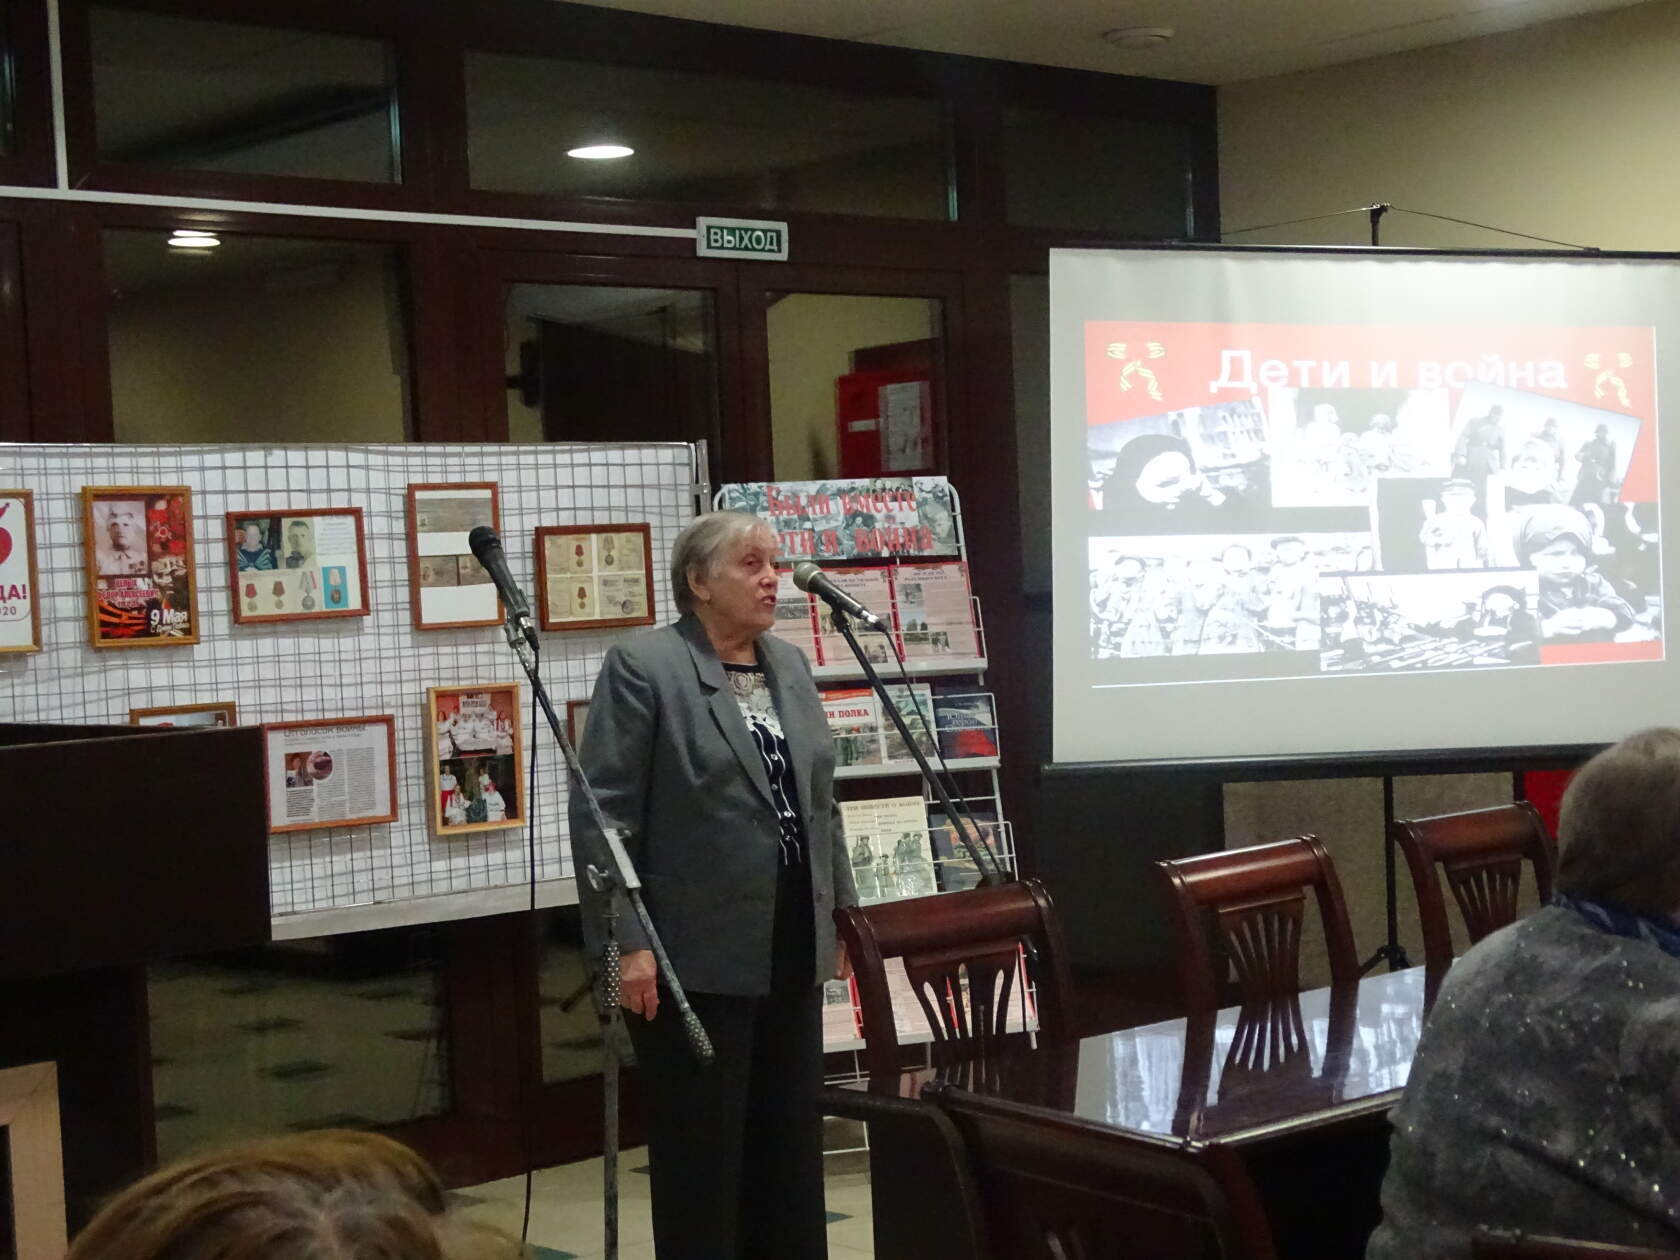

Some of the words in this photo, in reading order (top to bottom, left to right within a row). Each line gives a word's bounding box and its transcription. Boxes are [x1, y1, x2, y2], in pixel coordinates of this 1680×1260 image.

[709, 228, 778, 252] ВЫХОД
[1209, 349, 1350, 394] Дети
[1370, 359, 1398, 389] и
[1416, 352, 1569, 391] война
[766, 485, 832, 517] Были
[840, 490, 918, 516] вместе
[854, 519, 935, 553] война
[0, 606, 16, 616] 20
[150, 609, 160, 625] 9
[163, 608, 188, 624] Мая
[838, 709, 870, 718] ПОЛКА
